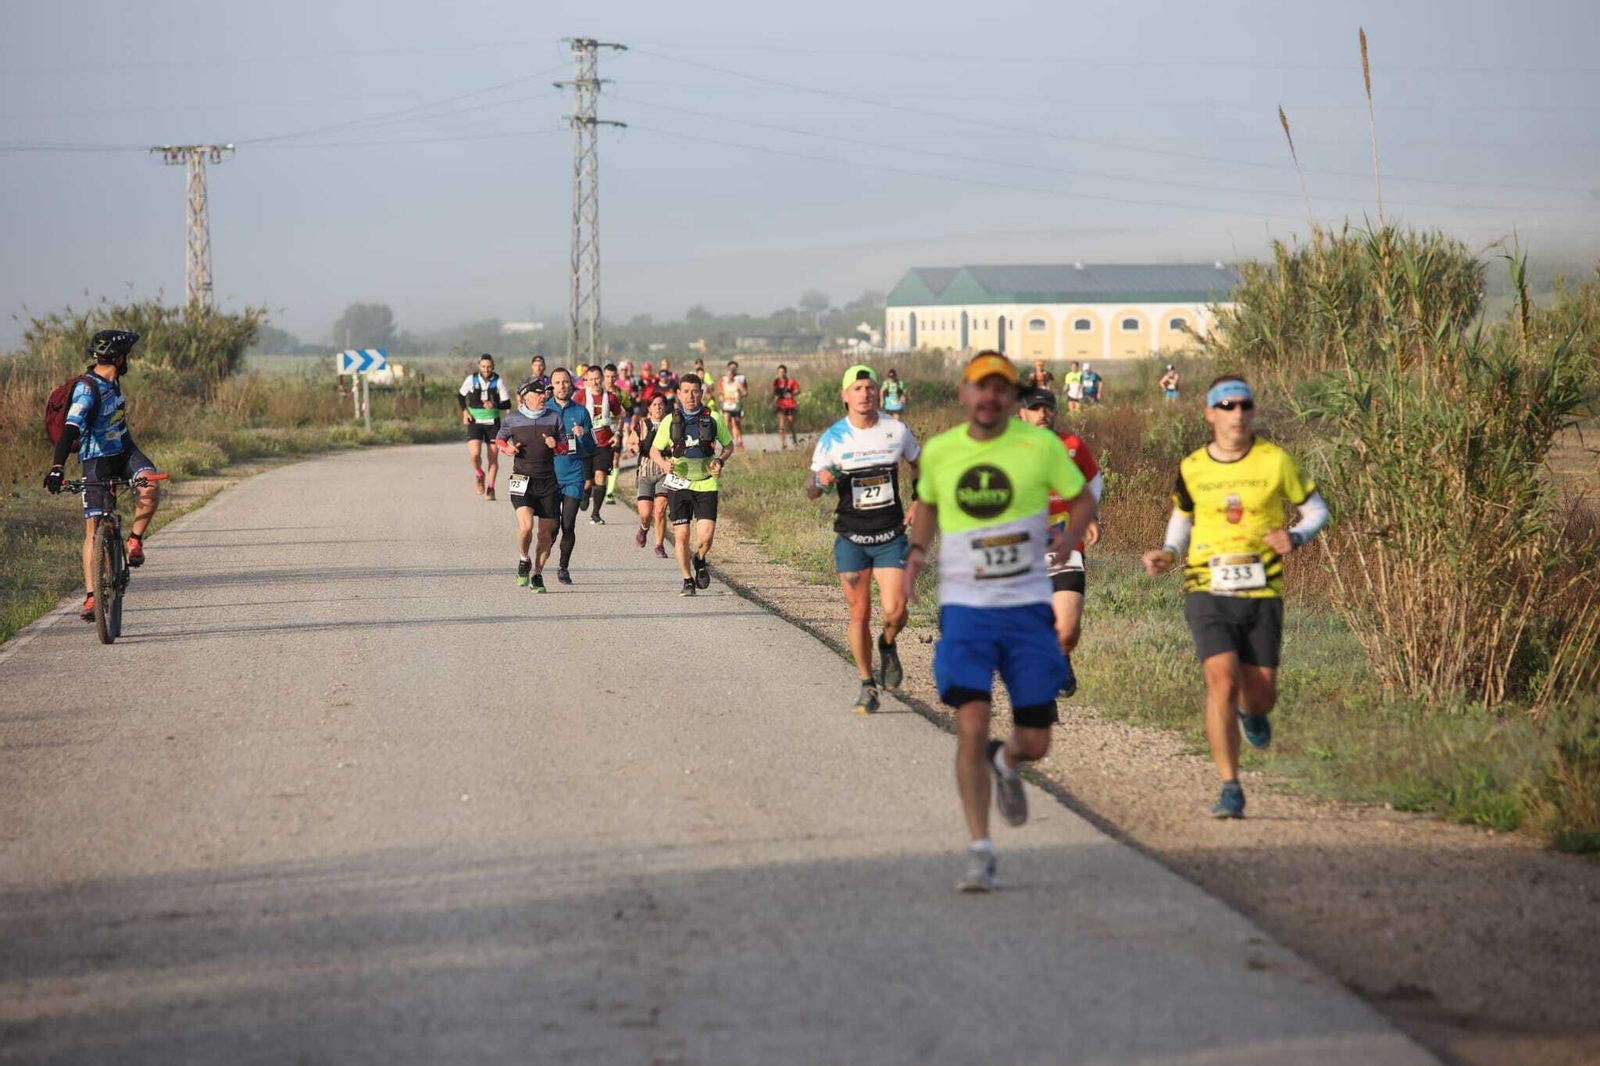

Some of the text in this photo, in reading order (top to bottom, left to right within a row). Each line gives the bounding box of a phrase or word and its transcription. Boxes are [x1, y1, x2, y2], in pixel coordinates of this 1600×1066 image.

[864, 486, 881, 498] 27
[875, 530, 896, 543] MAX
[984, 546, 1018, 566] 122
[1221, 567, 1252, 581] 233
